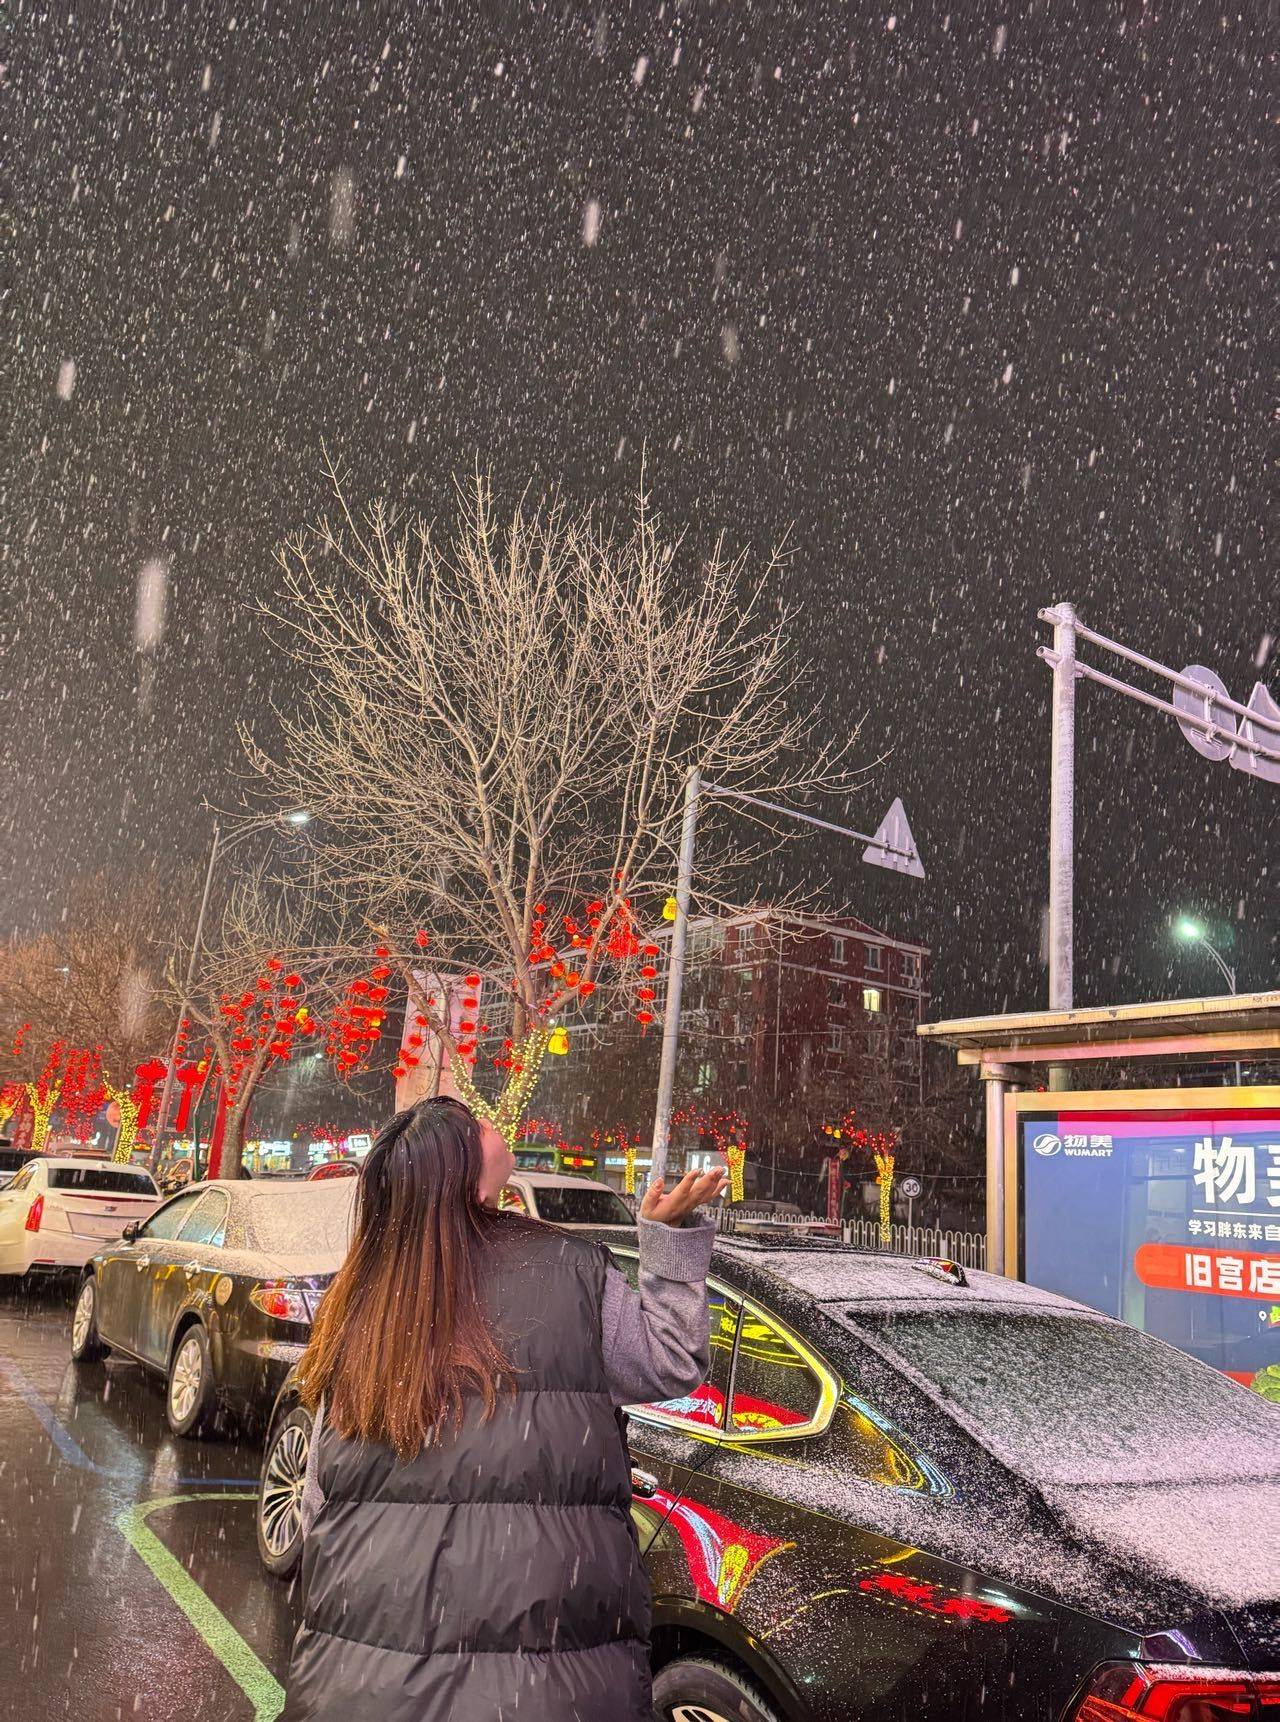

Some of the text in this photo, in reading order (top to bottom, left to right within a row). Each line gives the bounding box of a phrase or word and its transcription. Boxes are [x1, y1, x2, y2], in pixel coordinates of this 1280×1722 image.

[1063, 1134, 1113, 1148] 物美
[1064, 1148, 1113, 1157] WUMART
[905, 1182, 919, 1193] 30
[1188, 1219, 1280, 1242] 学习胖东来自
[1185, 1252, 1280, 1294] 旧宫店
